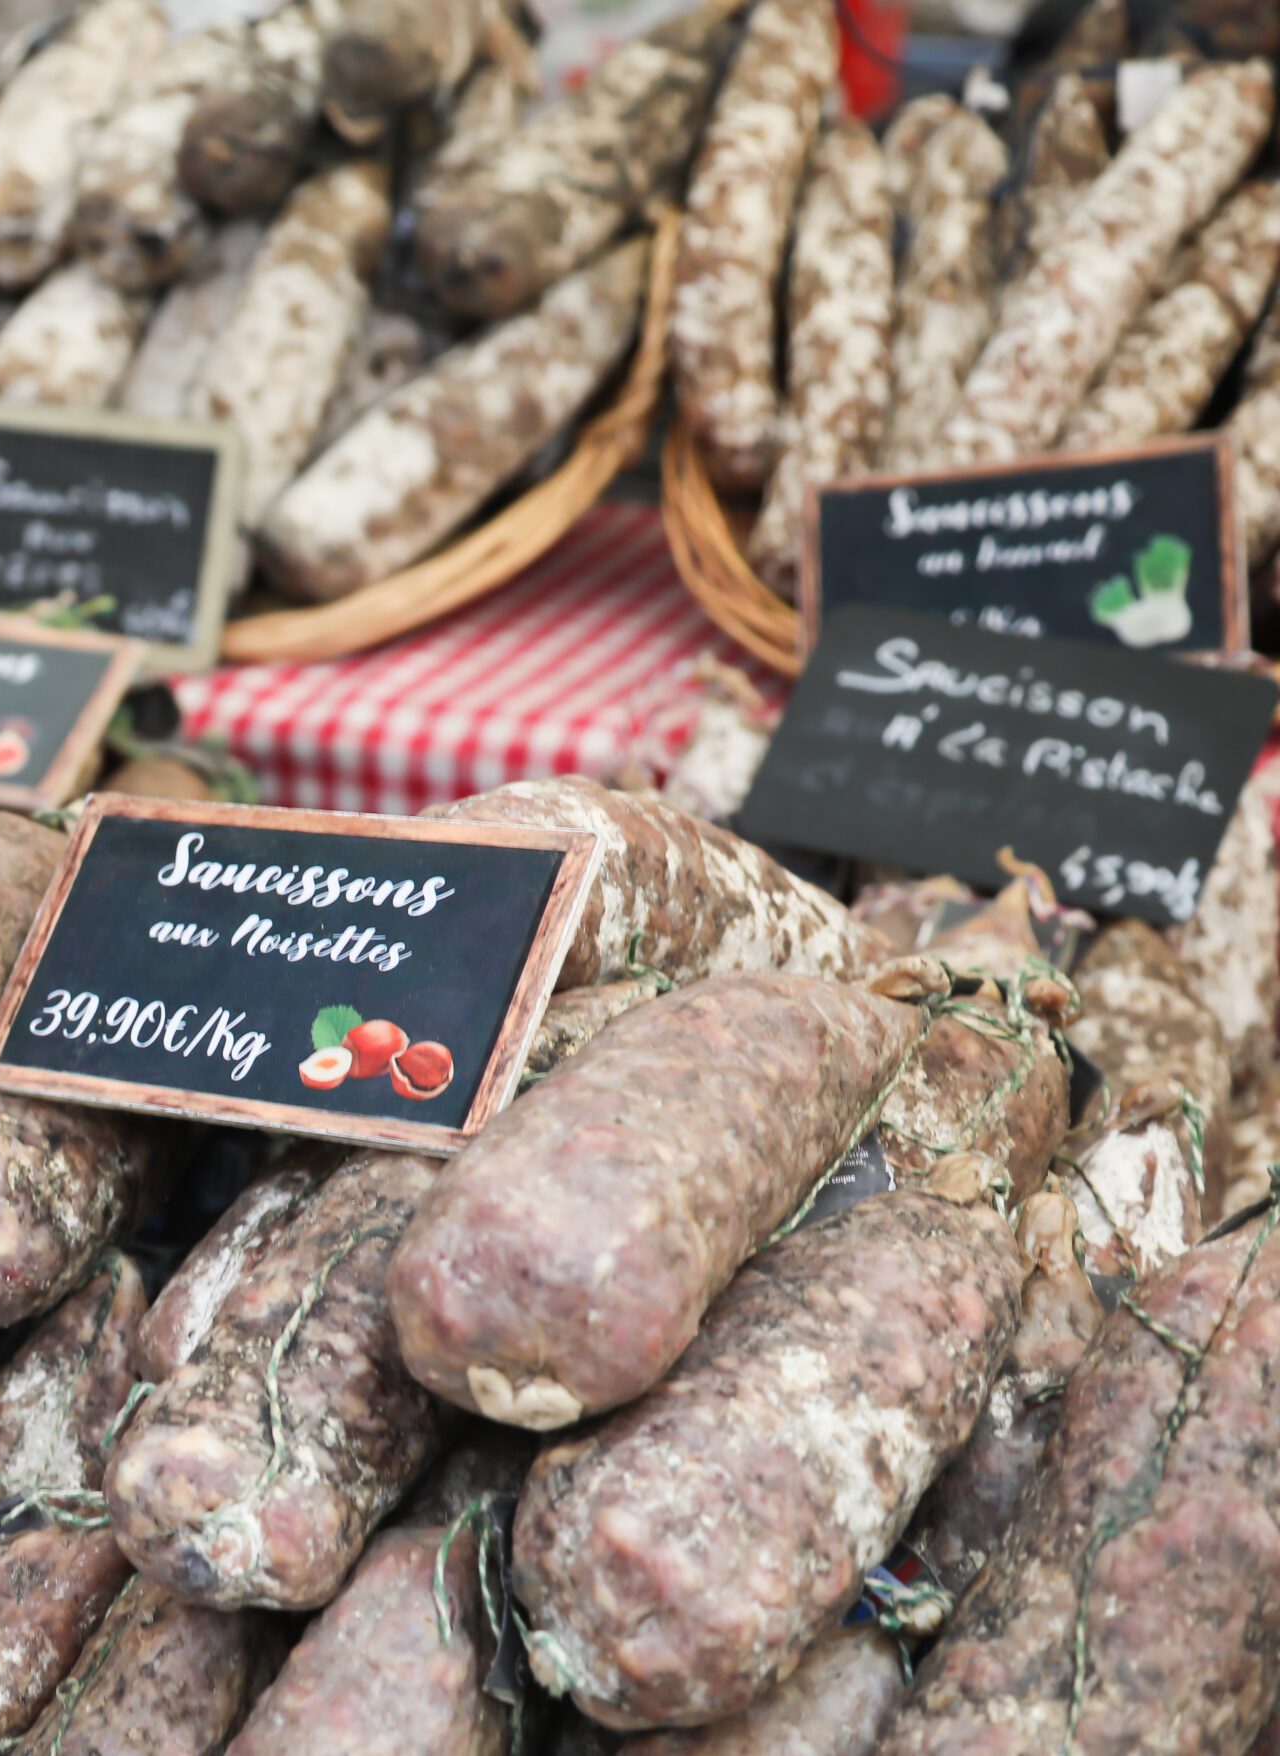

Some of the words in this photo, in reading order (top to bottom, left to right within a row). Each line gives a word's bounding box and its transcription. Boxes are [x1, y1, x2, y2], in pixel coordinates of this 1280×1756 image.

[836, 636, 1170, 747] Saucisson
[158, 831, 455, 917] Saucissons
[149, 920, 219, 948] aux
[231, 913, 412, 972] Noisettes
[29, 988, 272, 1082] 39,90€/Kg
